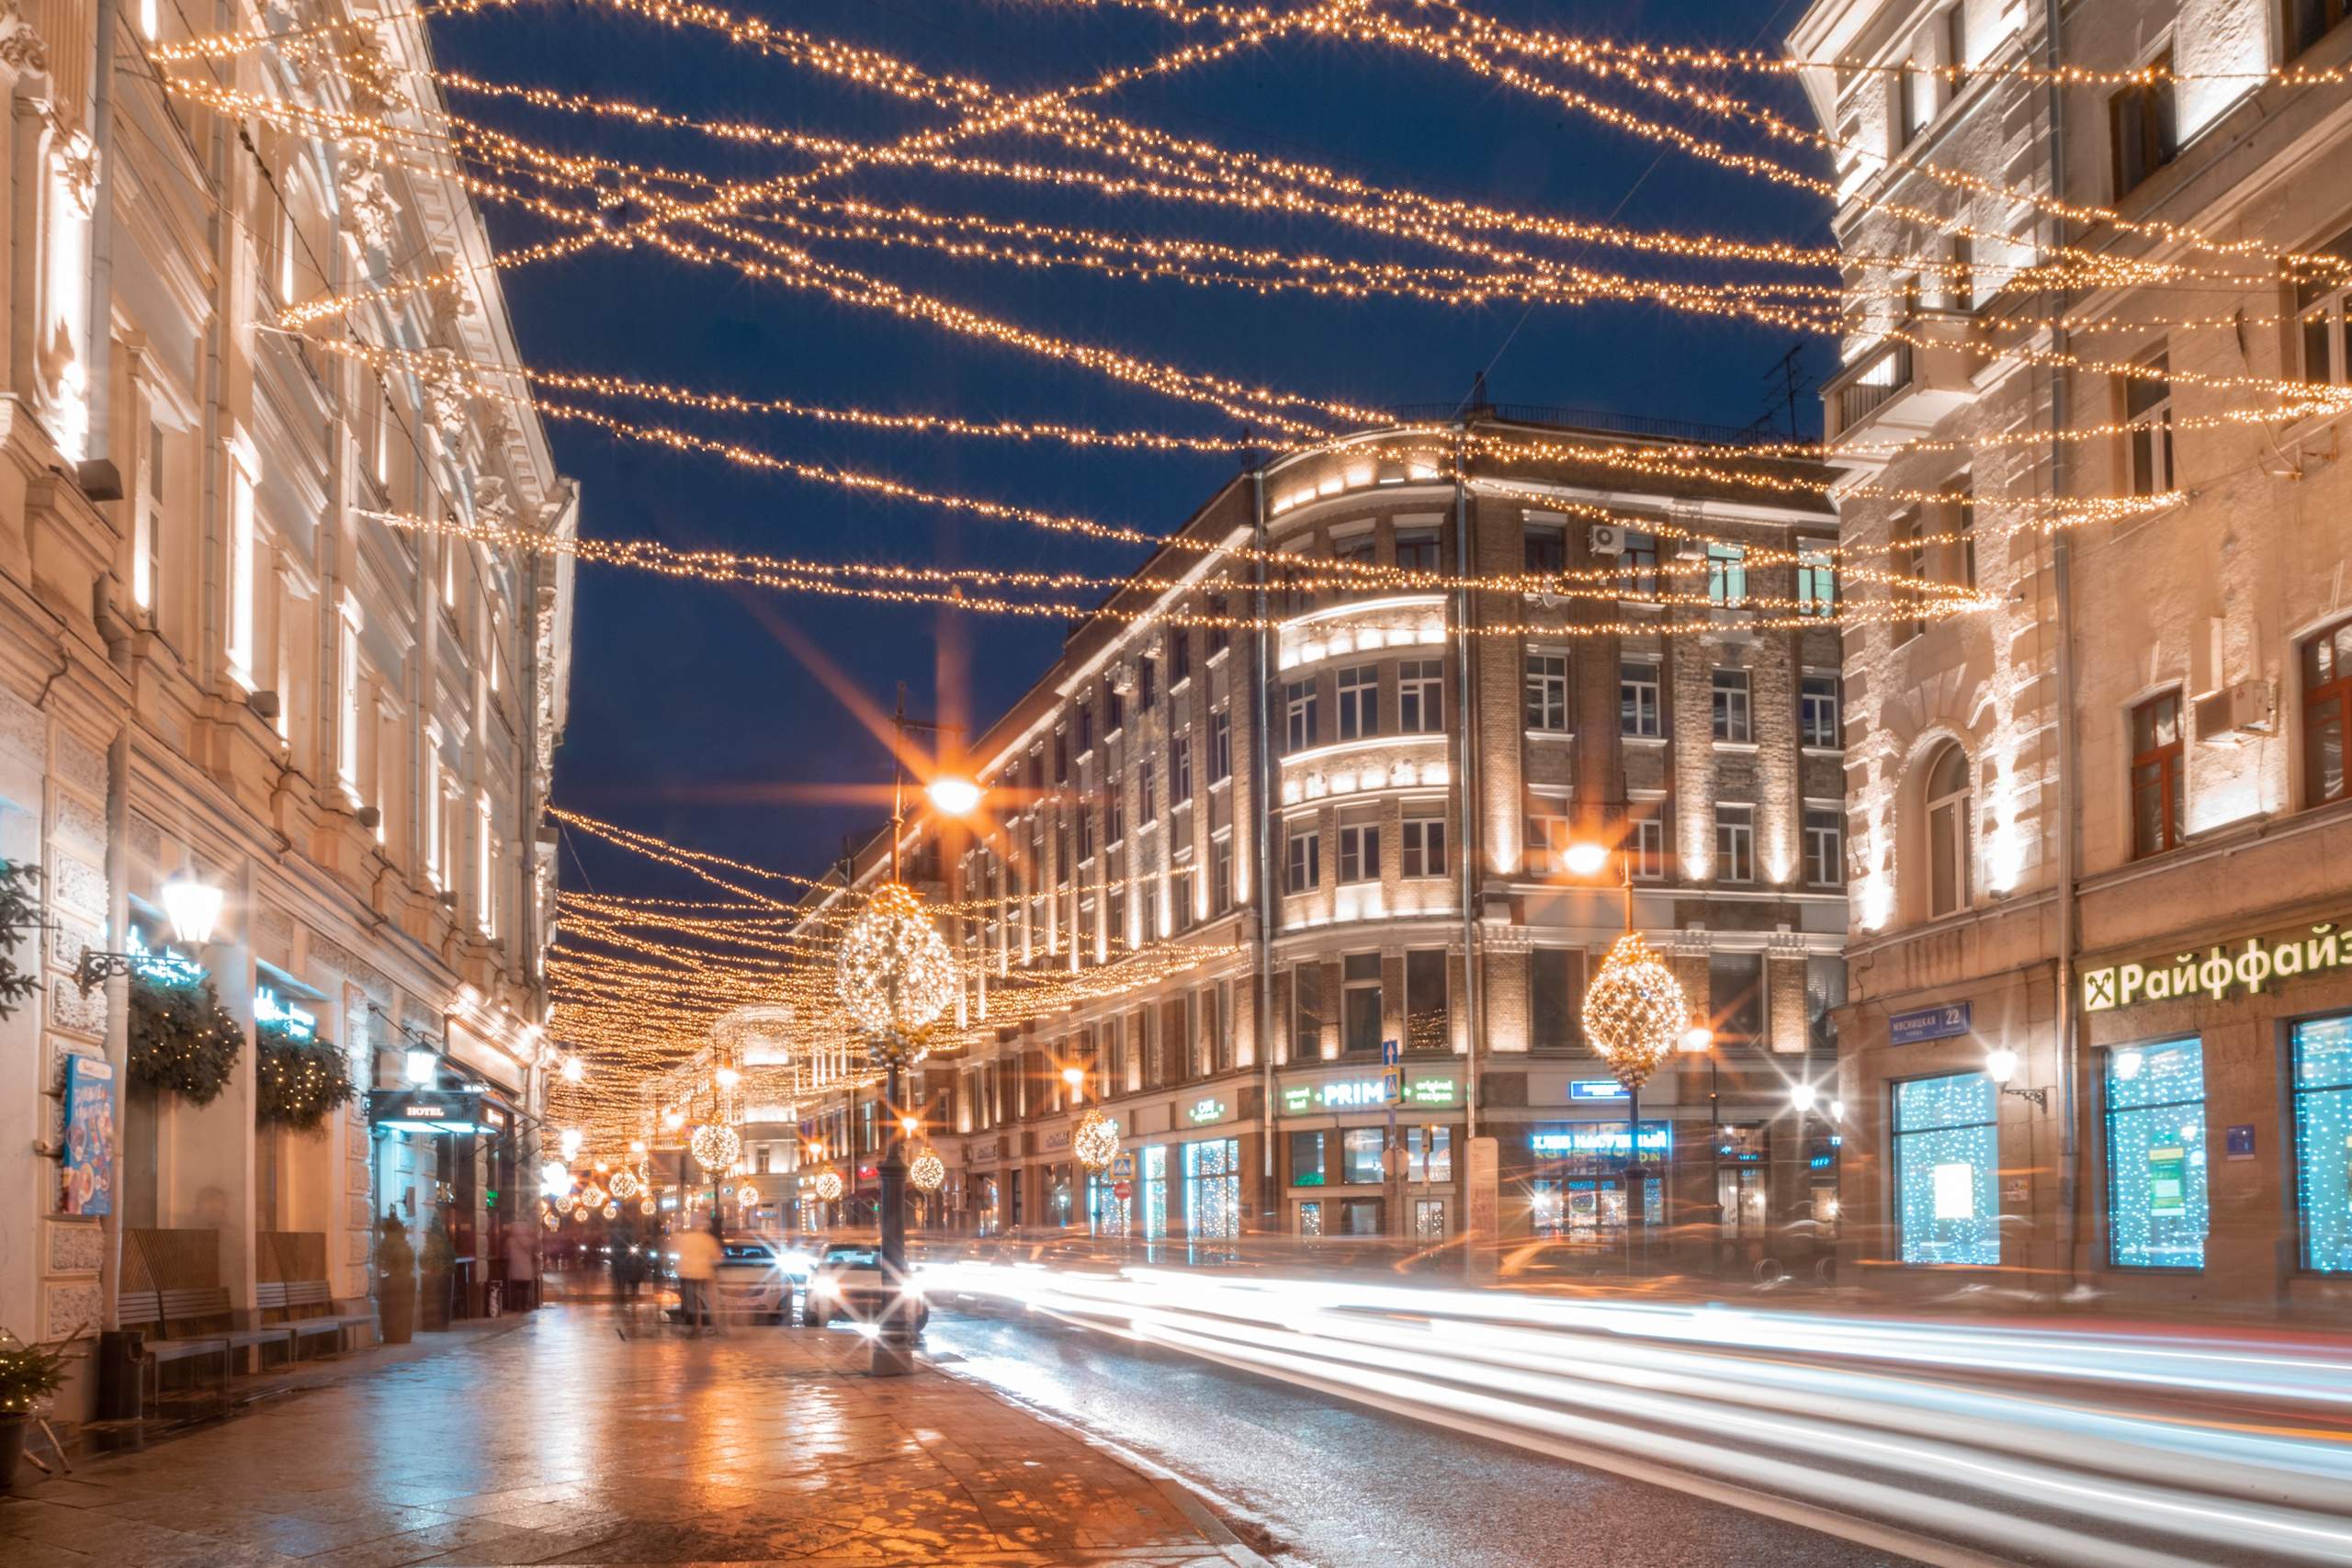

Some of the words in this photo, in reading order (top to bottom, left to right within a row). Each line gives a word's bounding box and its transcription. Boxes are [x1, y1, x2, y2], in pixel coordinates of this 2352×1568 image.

[1893, 1016, 1936, 1031] МЯСНИЦКАЯ
[1945, 1009, 1959, 1025] 22
[1416, 1080, 1453, 1092] original
[1324, 1082, 1384, 1106] PRIM
[1417, 1092, 1453, 1102] recipes
[406, 1106, 445, 1116] HOTEL
[1532, 1135, 1572, 1149] ХЛЕБ
